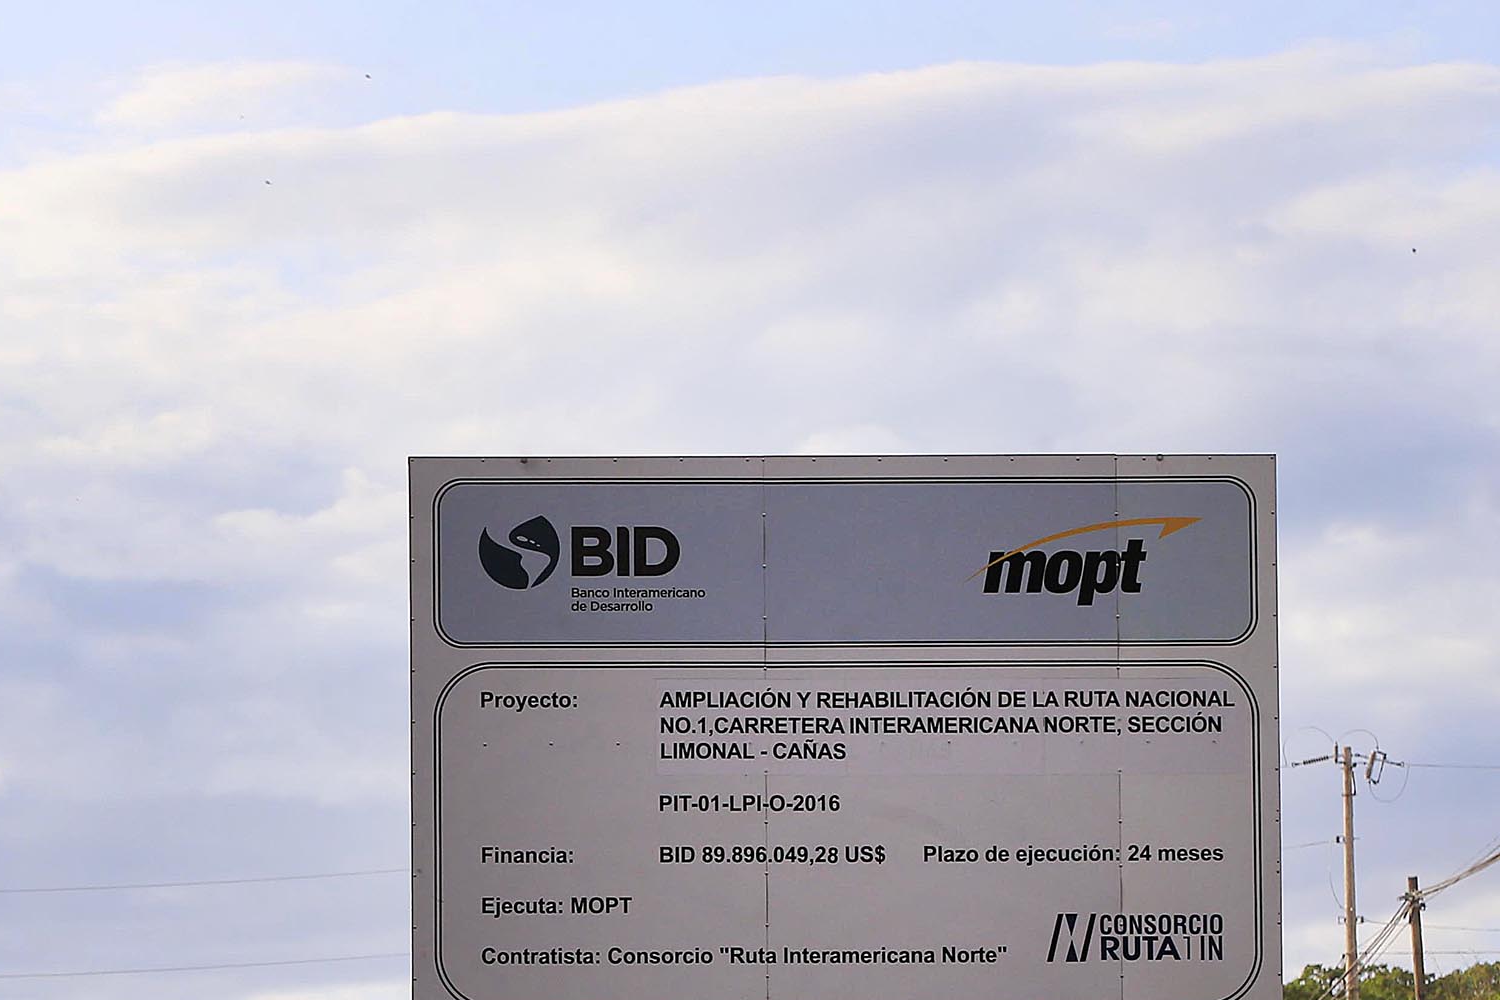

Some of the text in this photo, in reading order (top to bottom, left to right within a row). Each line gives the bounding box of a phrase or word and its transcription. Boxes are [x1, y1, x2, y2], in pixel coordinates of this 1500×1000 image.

[571, 526, 681, 577] BID
[983, 539, 1148, 606] mopt
[571, 586, 706, 599] Banco Interamericano
[571, 600, 653, 612] de Desarrollo
[481, 691, 578, 712] Proyecto:
[660, 686, 1236, 709] AMPLIACIÓN Y REHABILITACIÓN DE LA RUTA NACIONAL
[850, 716, 1040, 734] INTERAMERICANA
[1044, 715, 1122, 737] NORTE,
[1127, 711, 1222, 733] SECCIÓN
[660, 742, 755, 760] LIMONAL
[772, 739, 846, 760] CAÑAS
[659, 794, 841, 812] PIT-01-LPI-O-2016
[481, 846, 574, 864] Financia:
[659, 844, 886, 866] BID 89.896.049,28 US$
[923, 844, 1224, 867] Plazo de ejecución: 24 meses
[481, 896, 633, 918] Ejecuta: MOPT
[1099, 914, 1223, 935] CONSORCIO
[481, 946, 1007, 965] Contratista: Consorcio "Ruta Interamericana Norte"
